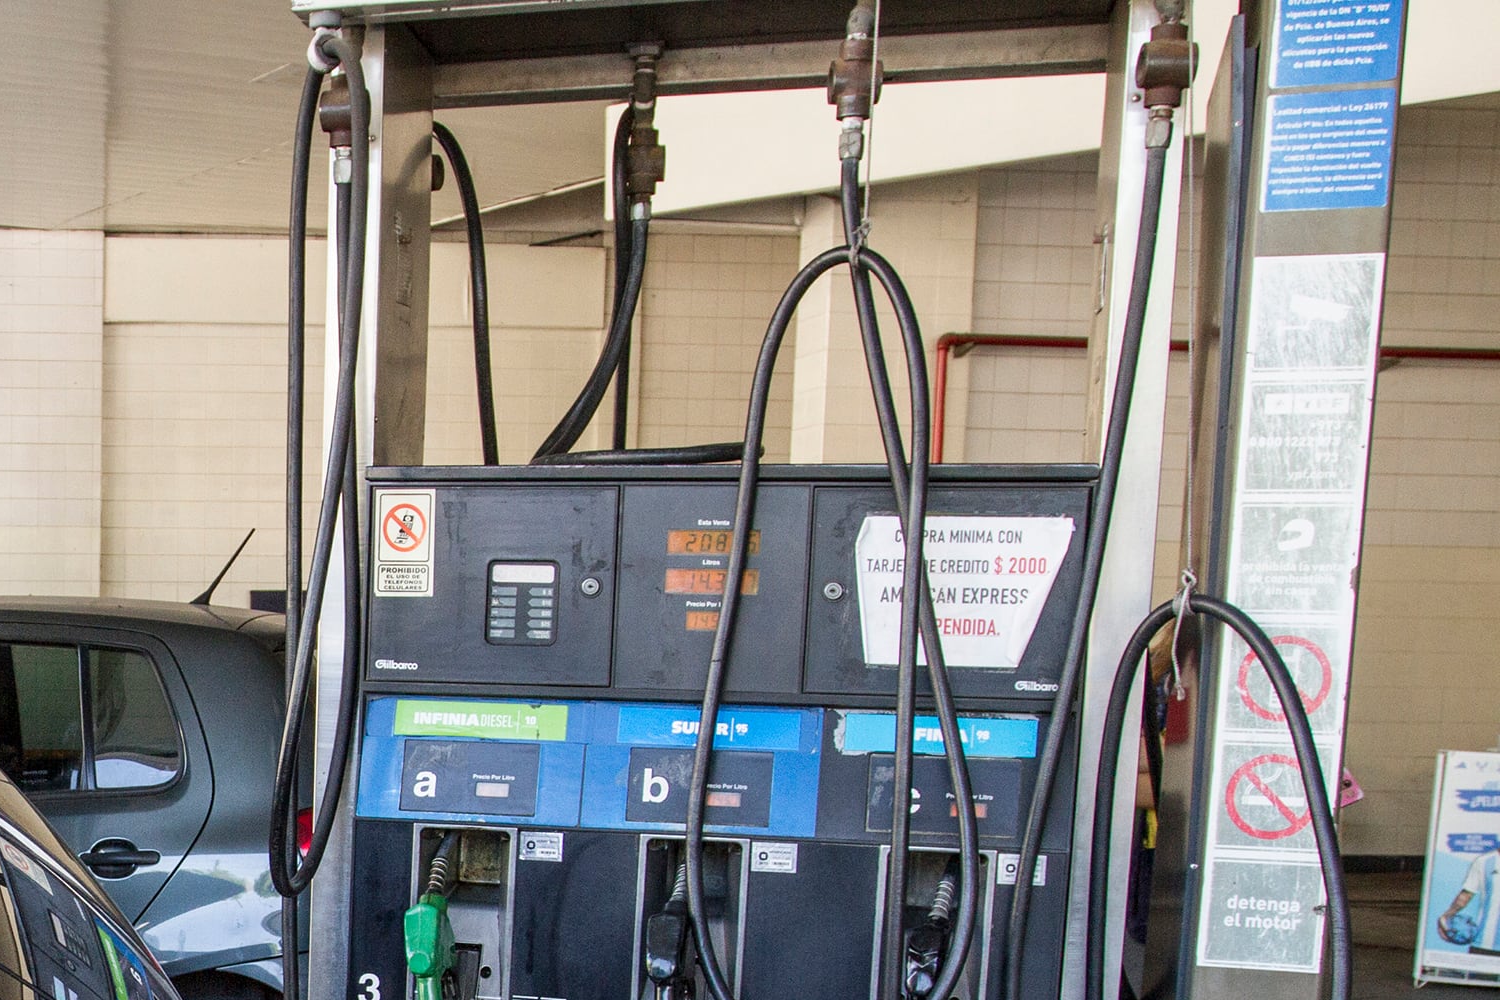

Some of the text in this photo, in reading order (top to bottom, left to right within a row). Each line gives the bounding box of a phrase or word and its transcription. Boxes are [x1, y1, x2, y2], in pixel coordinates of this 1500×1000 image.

[1284, 24, 1294, 32] de
[1314, 22, 1324, 30] de
[1326, 20, 1354, 28] Buenos
[1356, 18, 1378, 26] Aires,
[1318, 47, 1336, 56] para
[1293, 61, 1304, 69] de
[1349, 104, 1362, 112] Ley
[894, 529, 1023, 544] CPRA MINIMA CON
[867, 558, 905, 573] TARJE
[940, 559, 989, 574] CREDITO
[993, 555, 1003, 575] $
[686, 600, 706, 608] Precio
[962, 588, 1029, 605] EXPRESS
[934, 618, 1001, 637] PENDIDA.
[374, 659, 418, 672] Gilbarco
[413, 711, 480, 727] INFINIA
[480, 714, 514, 728] DIESEL
[671, 720, 748, 736] SUR 95
[413, 771, 436, 798] a
[642, 768, 669, 804] b
[1226, 894, 1300, 915] detenga
[1224, 912, 1302, 930] el motor
